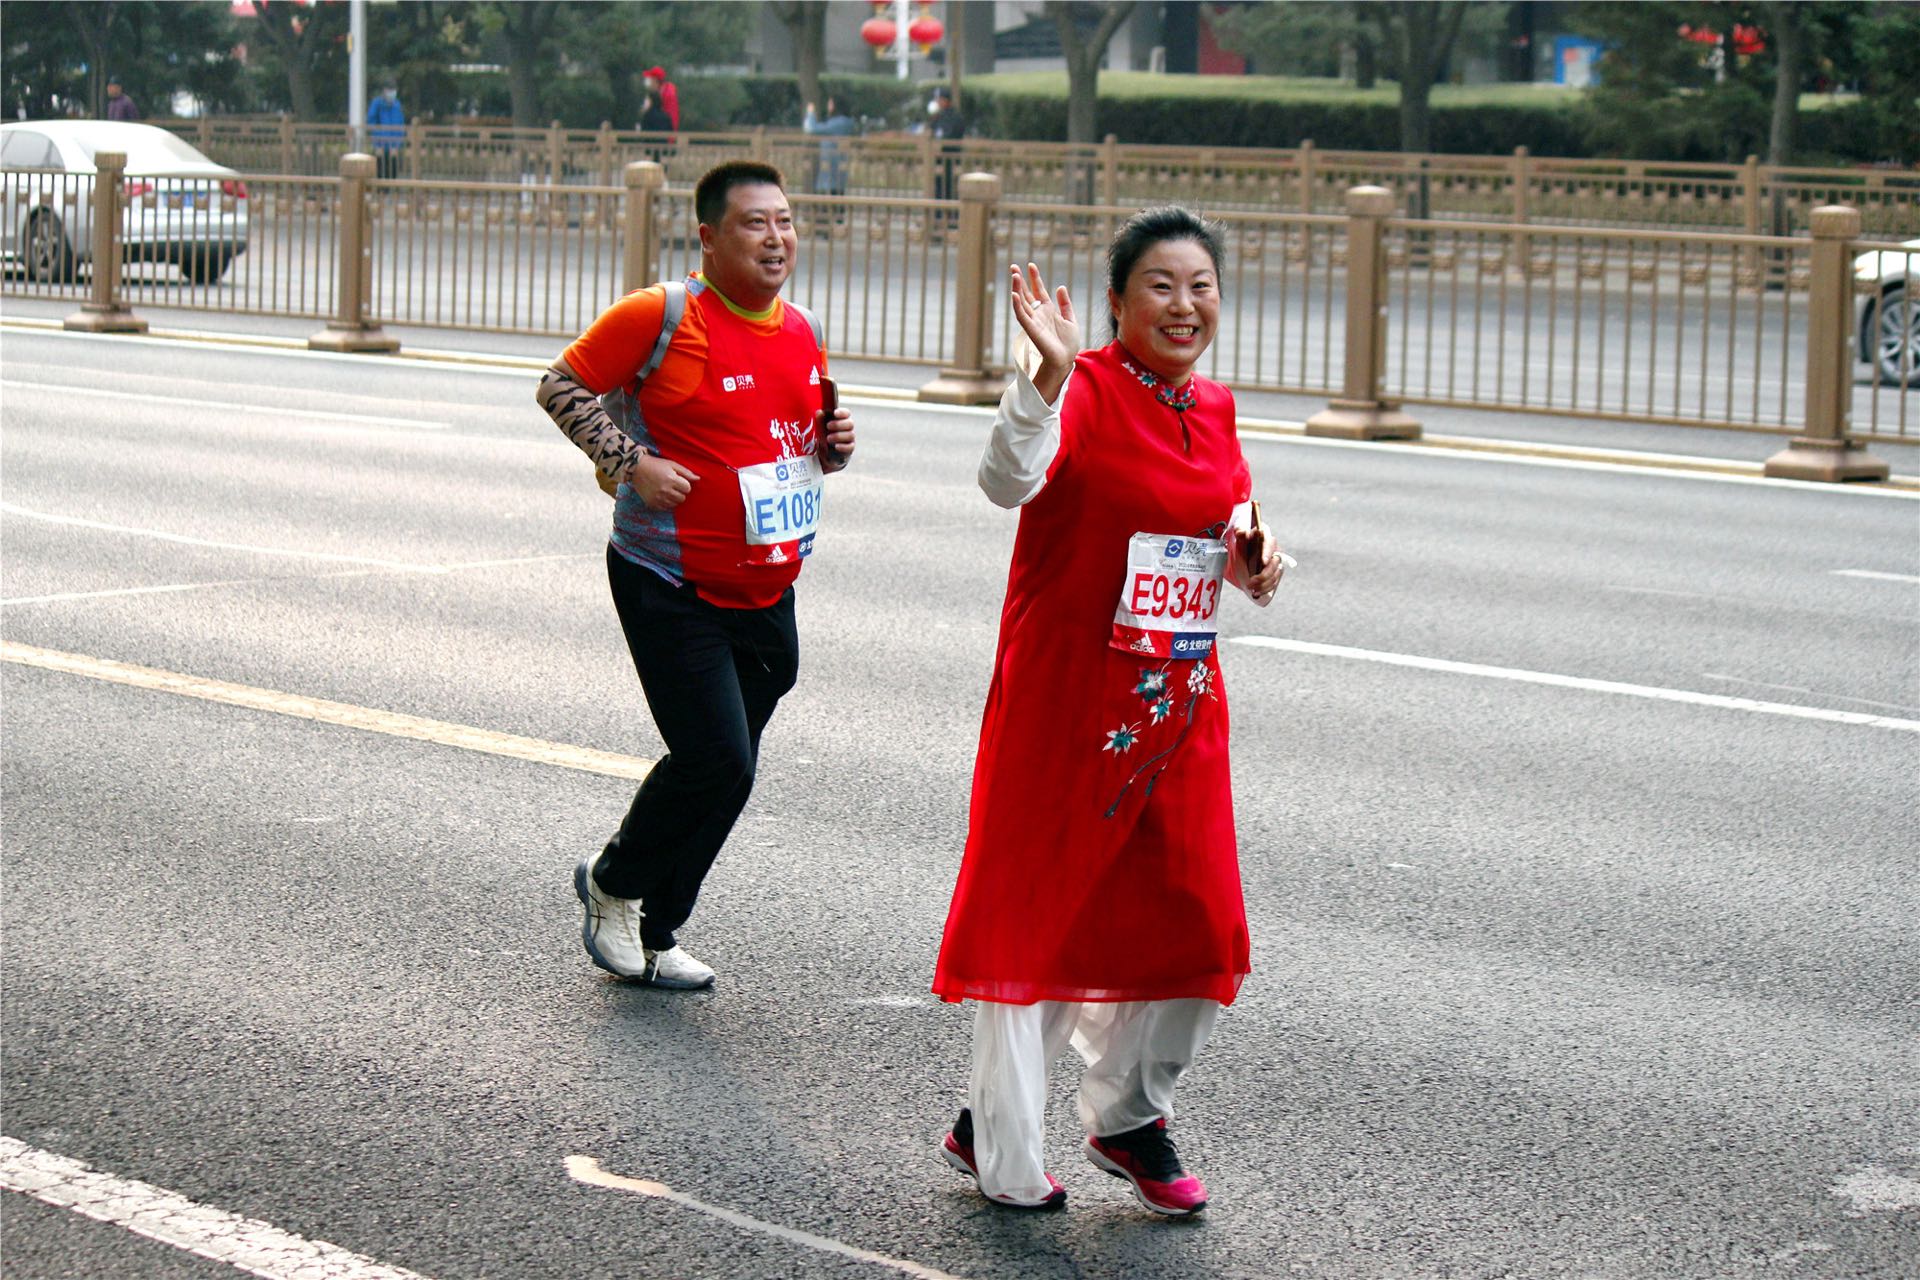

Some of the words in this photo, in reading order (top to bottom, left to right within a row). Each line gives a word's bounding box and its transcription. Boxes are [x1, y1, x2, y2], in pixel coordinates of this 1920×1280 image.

[755, 487, 821, 535] E1081
[1184, 541, 1208, 557] 贝壳
[1131, 573, 1218, 620] E9343
